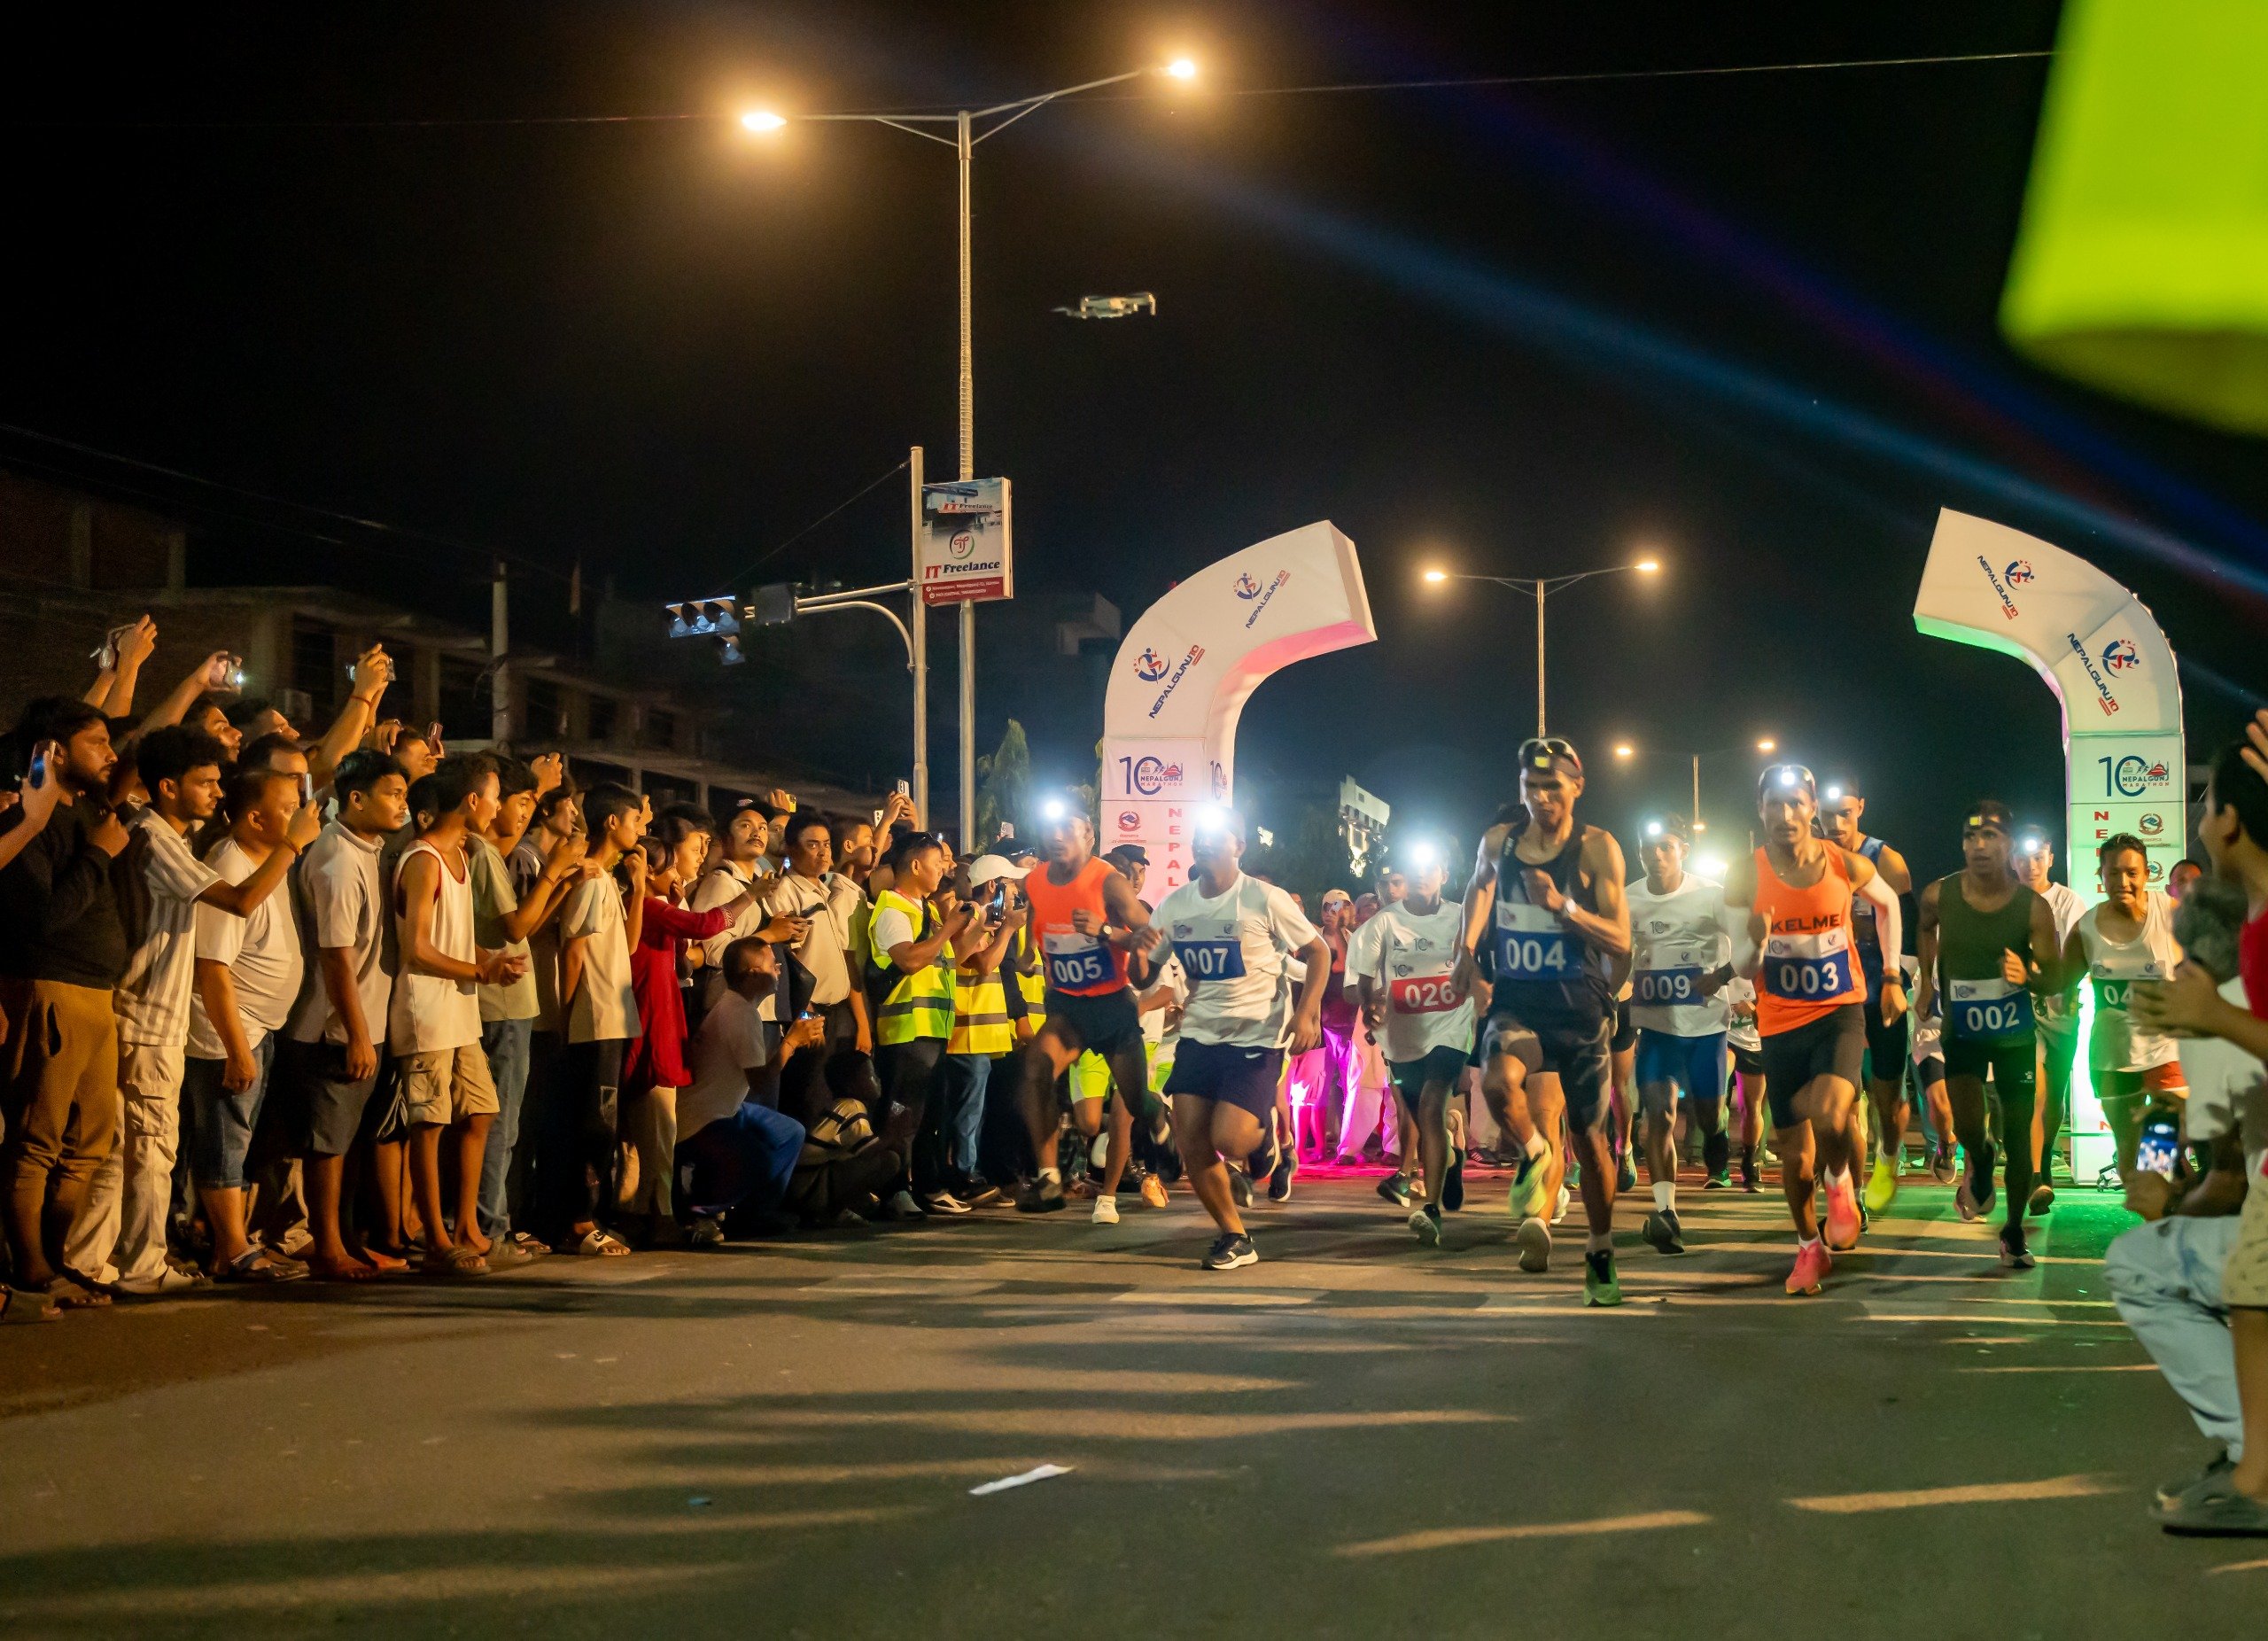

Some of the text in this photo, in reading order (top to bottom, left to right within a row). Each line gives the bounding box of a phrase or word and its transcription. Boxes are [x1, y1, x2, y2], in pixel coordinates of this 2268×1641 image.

[925, 564, 942, 579] IT
[943, 560, 1000, 574] Freelance
[1772, 914, 1840, 933] KELME
[1184, 948, 1229, 975] 007
[1507, 937, 1566, 973] 004
[1053, 955, 1103, 984] 005
[1780, 961, 1839, 993] 003
[1404, 981, 1456, 1008] 026
[1642, 975, 1691, 1000] 009
[1967, 1002, 2020, 1031] 002
